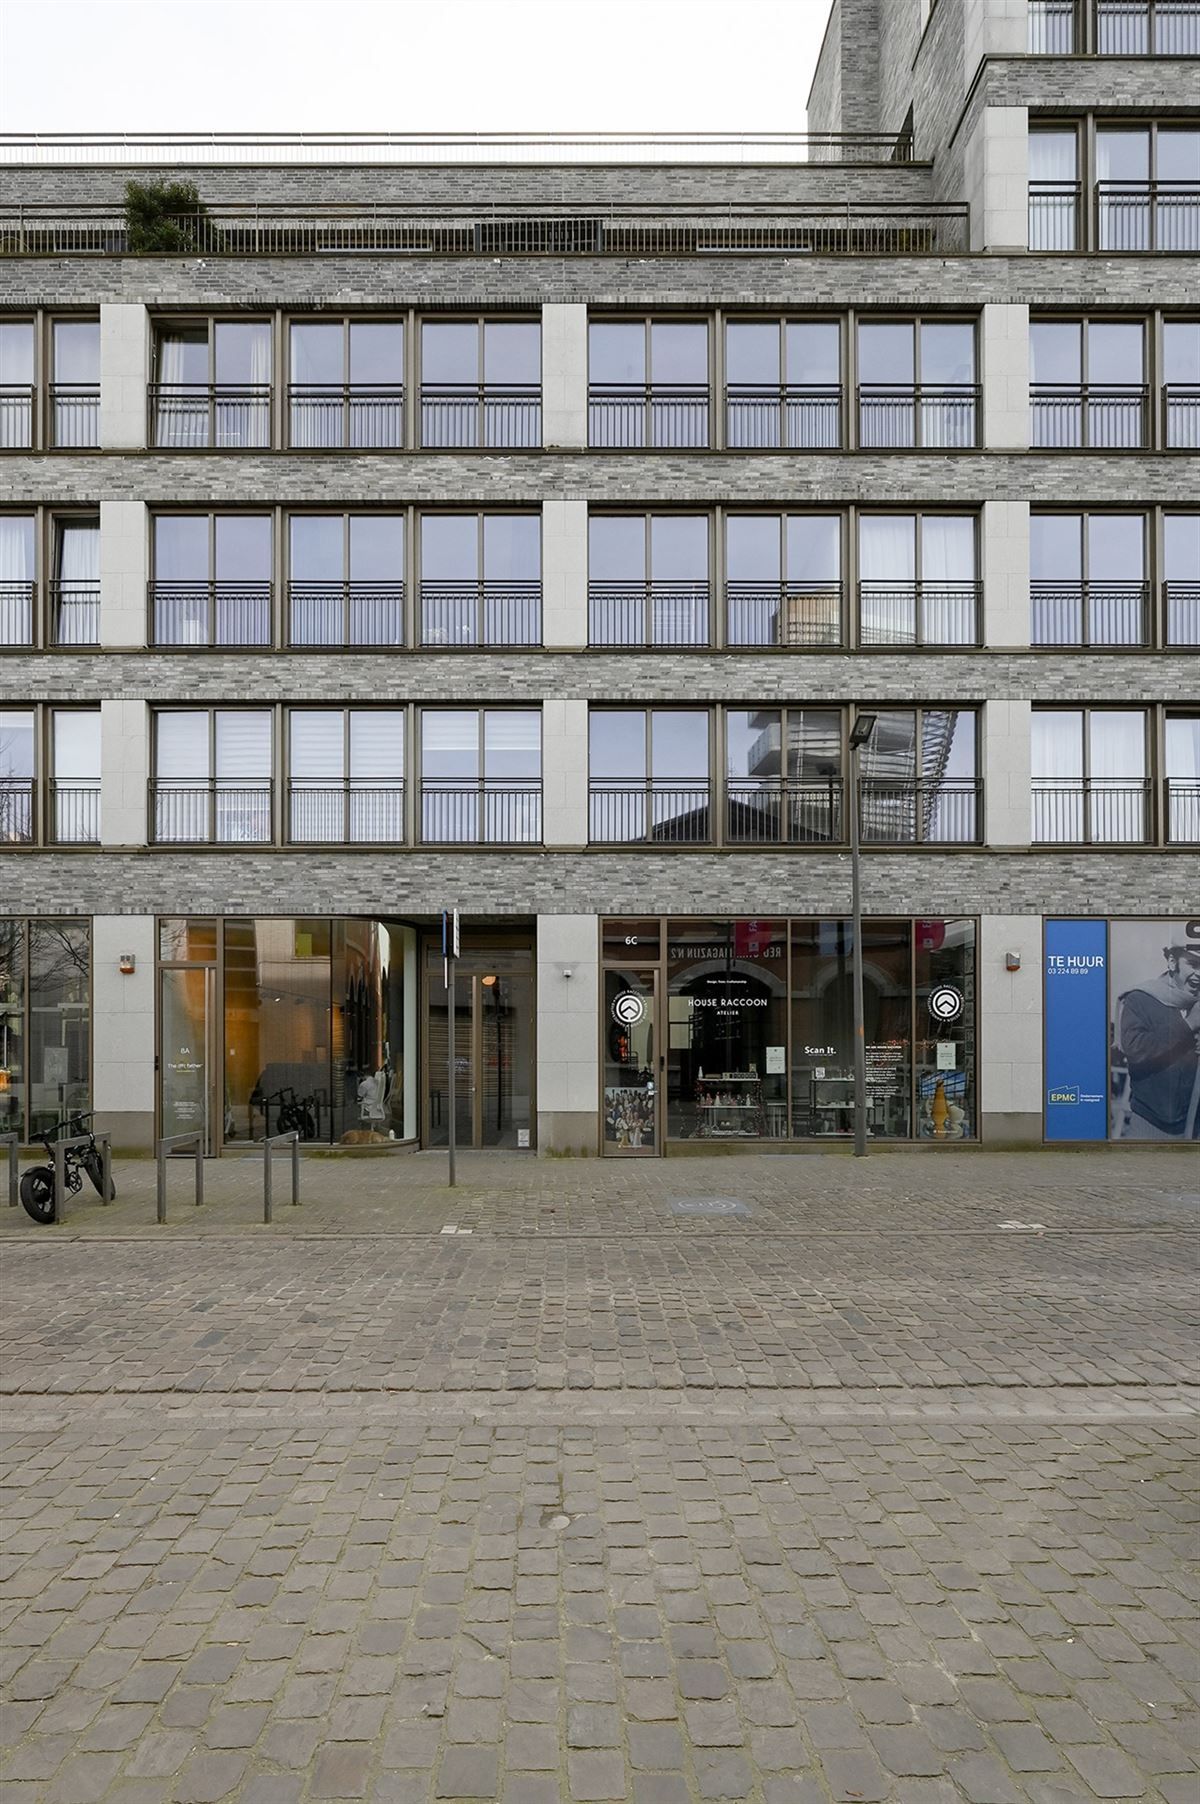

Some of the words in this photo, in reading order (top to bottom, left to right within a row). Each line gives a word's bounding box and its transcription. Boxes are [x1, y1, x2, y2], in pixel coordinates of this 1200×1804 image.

[625, 936, 638, 945] 6C
[1048, 955, 1065, 967] TE
[1067, 955, 1104, 967] HUUR
[1047, 967, 1057, 975] 03
[1057, 967, 1070, 975] 224
[1070, 967, 1079, 975] 89
[1079, 967, 1089, 975] 89
[688, 998, 717, 1007] HOUSE
[720, 998, 768, 1007] RACCOON
[804, 1045, 825, 1054] Scan
[827, 1046, 837, 1054] It.
[1051, 1093, 1076, 1102] EPMC
